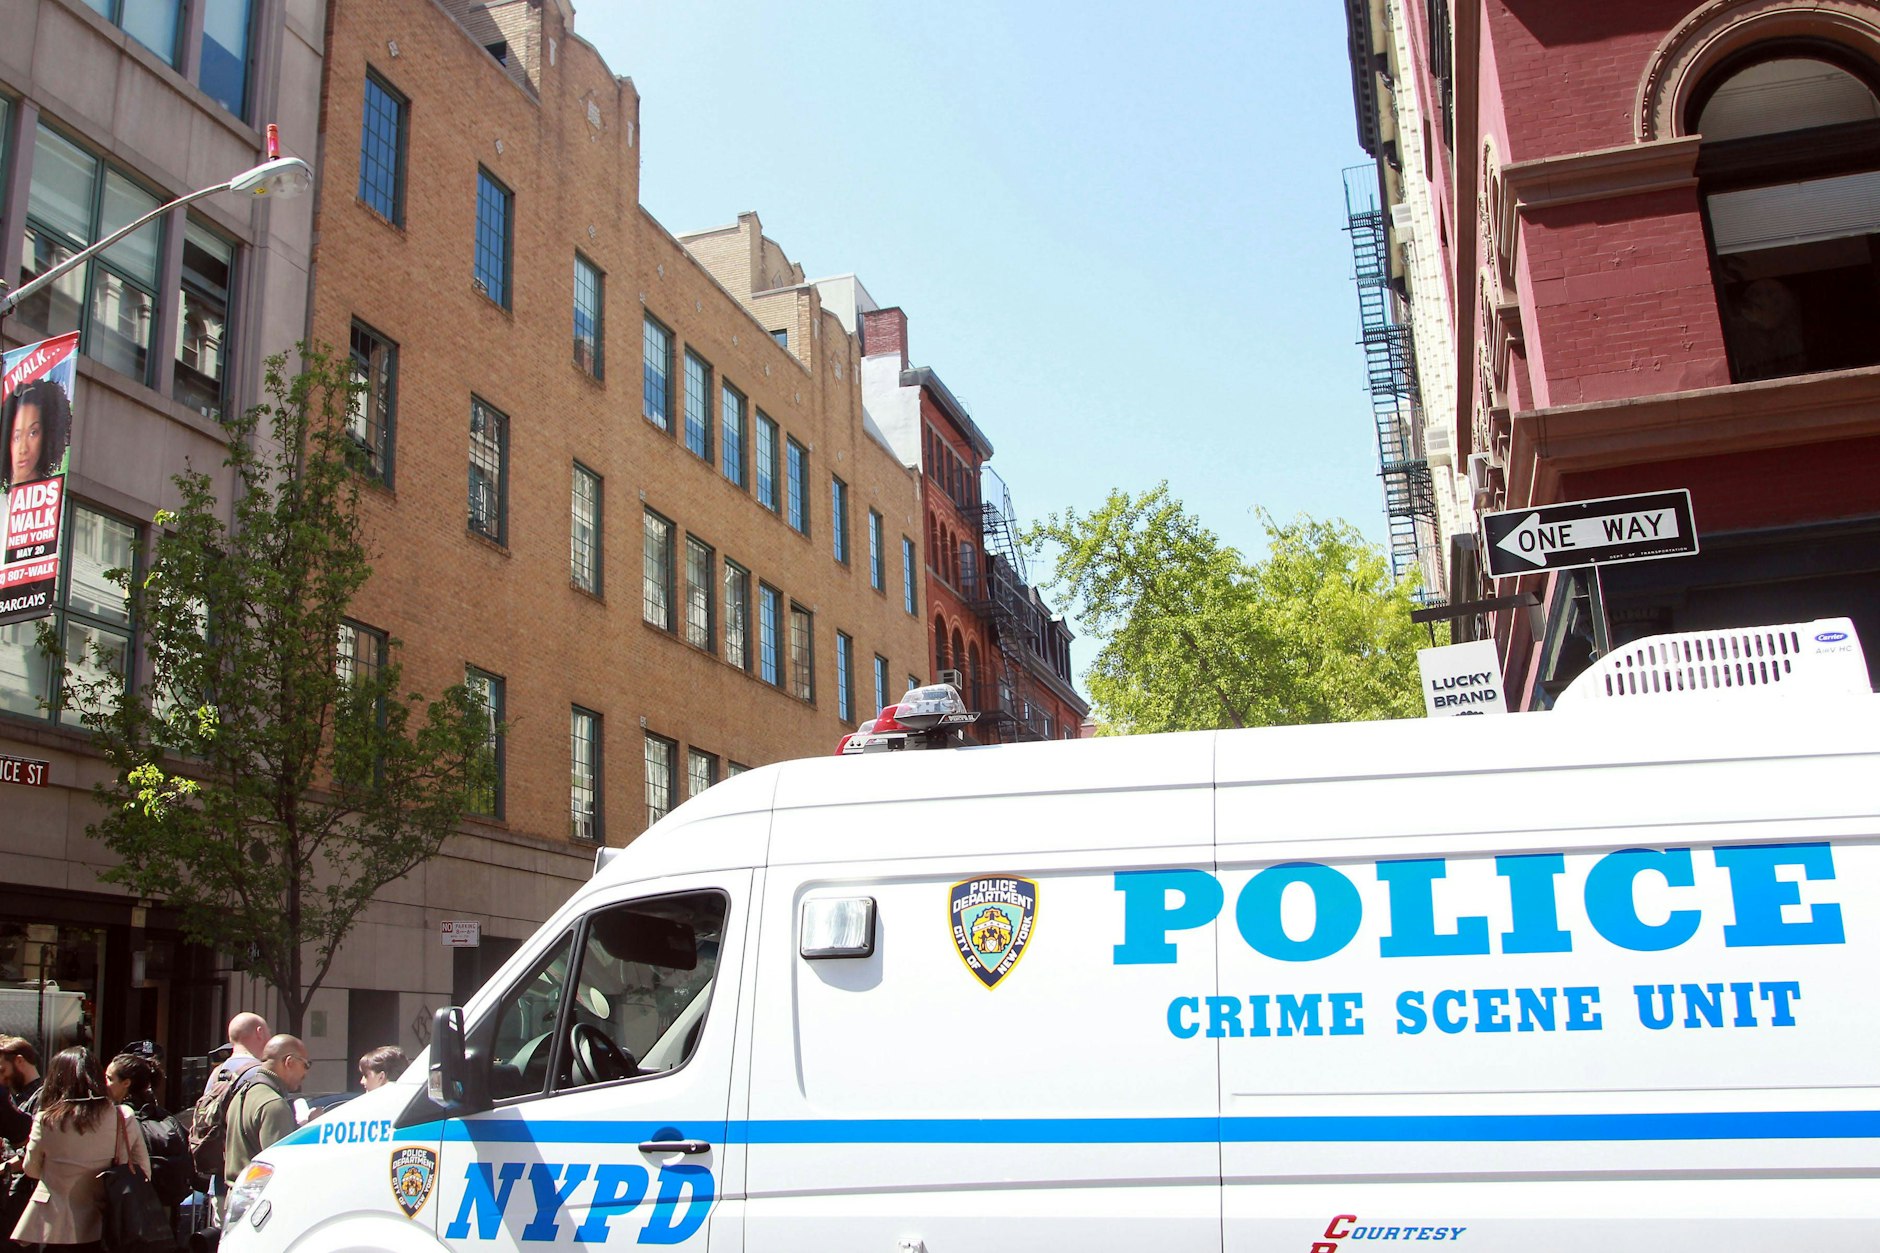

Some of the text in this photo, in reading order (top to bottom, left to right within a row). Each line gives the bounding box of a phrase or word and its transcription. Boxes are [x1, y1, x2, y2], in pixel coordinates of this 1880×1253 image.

[4, 380, 10, 394] I
[12, 481, 59, 513] AIDS
[11, 506, 57, 534] WALK
[8, 527, 56, 547] NEW YORK
[1518, 513, 1664, 553] ONE WAY
[16, 545, 45, 560] MAY 20
[1640, 547, 1688, 556] TRANSPORTATION
[8, 561, 55, 582] 807-WALK
[0, 592, 47, 614] BARCLAYS
[1432, 672, 1493, 692] LUCKY
[1433, 689, 1498, 709] BRAND
[27, 763, 44, 785] ST
[970, 879, 1018, 895] POLICE
[953, 890, 1033, 914] DEPARTMENT
[1113, 842, 1846, 965] POLICE
[442, 923, 452, 932] NO
[953, 915, 1033, 975] CITY OF NEW YORK
[1167, 981, 1802, 1039] CRIME SCENE UNIT
[322, 1120, 391, 1144] POLICE
[393, 1157, 434, 1169] DEPARTMENT
[402, 1149, 427, 1158] POLICE
[392, 1174, 434, 1210] CITY OF NEW YORK
[445, 1162, 716, 1245] NYPD
[1324, 1214, 1467, 1240] COURTESY
